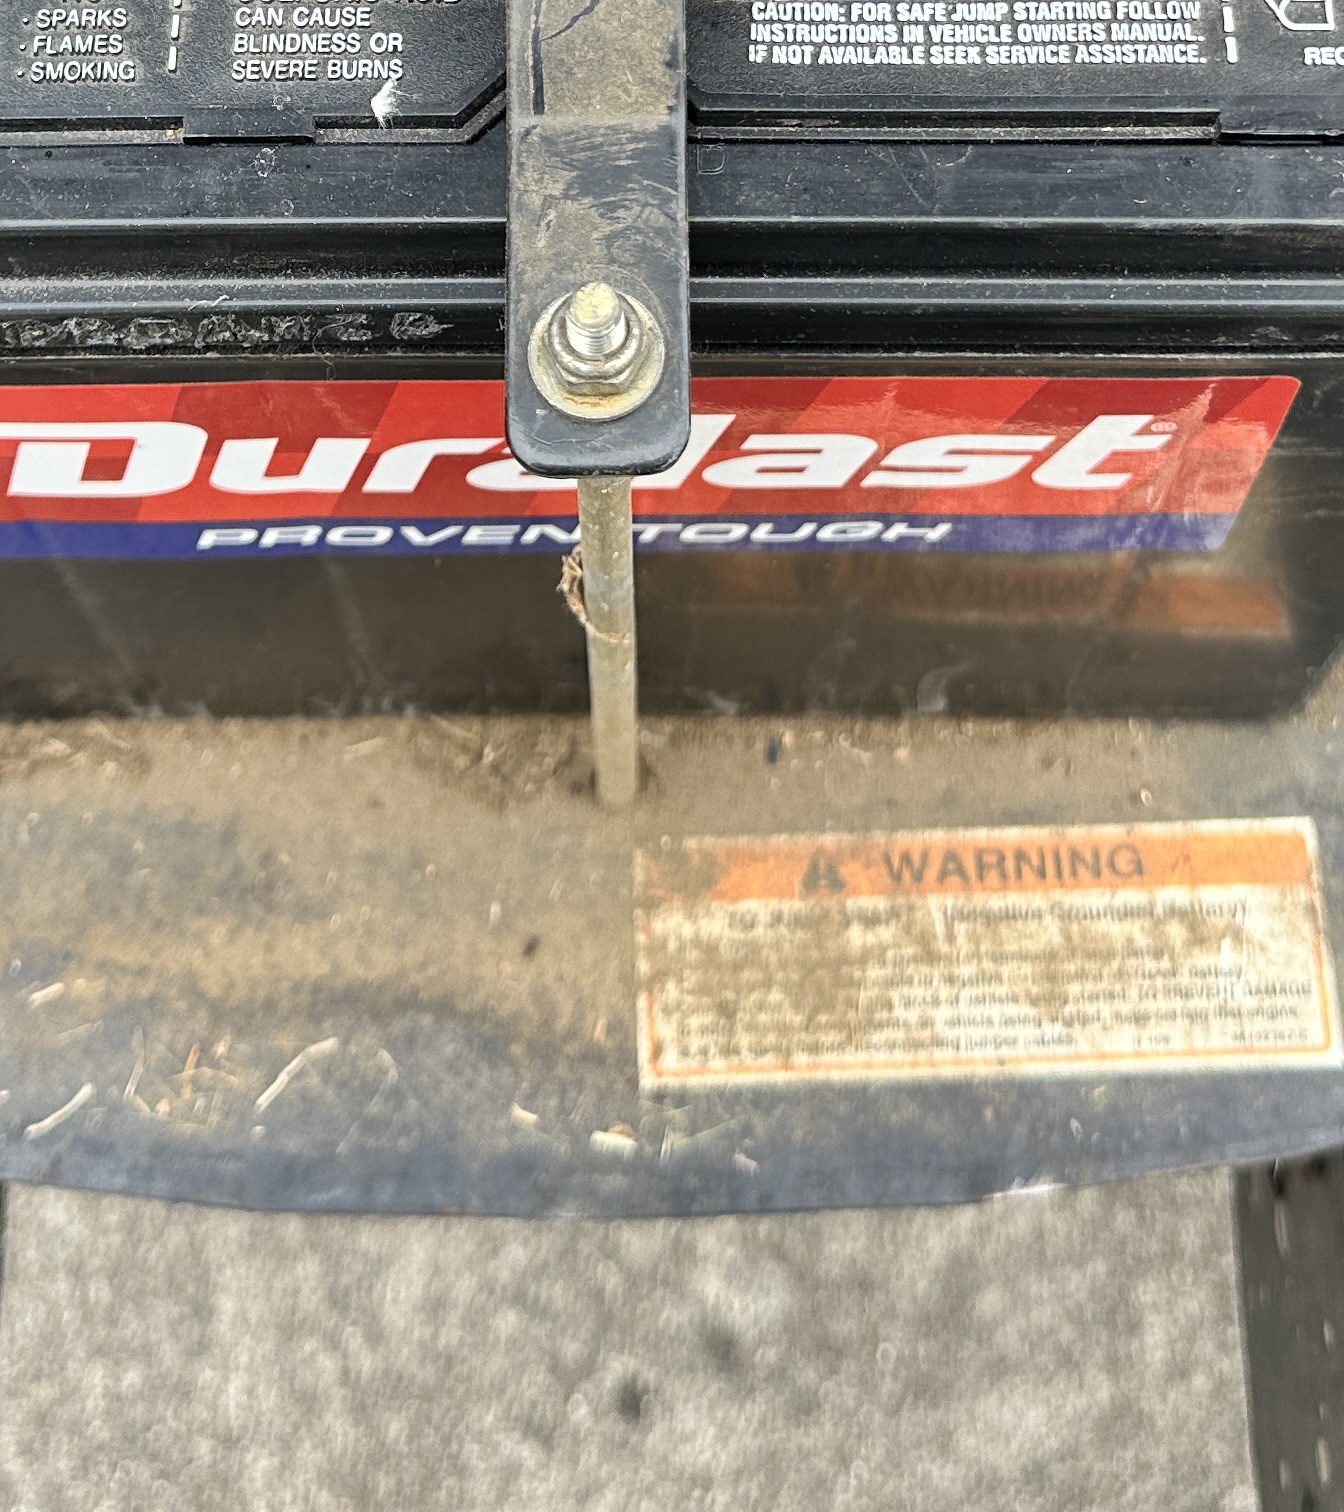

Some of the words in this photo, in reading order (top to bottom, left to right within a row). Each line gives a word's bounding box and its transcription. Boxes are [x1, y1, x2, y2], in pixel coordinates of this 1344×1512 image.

[36, 9, 128, 30] SPARKS
[234, 8, 284, 28] CAN
[292, 7, 371, 28] CAUSE
[751, 1, 847, 23] CAUTION:
[850, 2, 892, 23] FOR
[896, 2, 947, 23] SAFE
[951, 1, 1008, 22] JUMP
[1012, 0, 1112, 21] STARTING
[1116, 0, 1201, 20] FOLLOW
[233, 33, 361, 54] BLINDNESS
[369, 33, 404, 54] OR
[750, 23, 898, 44] INSTRUCTIONS
[903, 23, 924, 44] IN
[928, 23, 1013, 44] VEHICLE
[1017, 22, 1106, 43] OWNERS
[1110, 21, 1205, 43] MANUAL.
[32, 35, 124, 55] FLAMES
[748, 44, 768, 64] IF
[772, 44, 814, 65] NOT
[817, 44, 926, 65] AVAILABLE
[929, 44, 982, 65] SEEK
[985, 44, 1071, 65] SERVICE
[1074, 43, 1207, 65] ASSISTANCE.
[29, 60, 137, 82] SMOKING
[231, 59, 317, 81] SEVERE
[326, 59, 404, 81] BURNS
[196, 522, 582, 550] PROVEN
[632, 519, 954, 546] TOUGH
[882, 843, 1146, 886] WARNING
